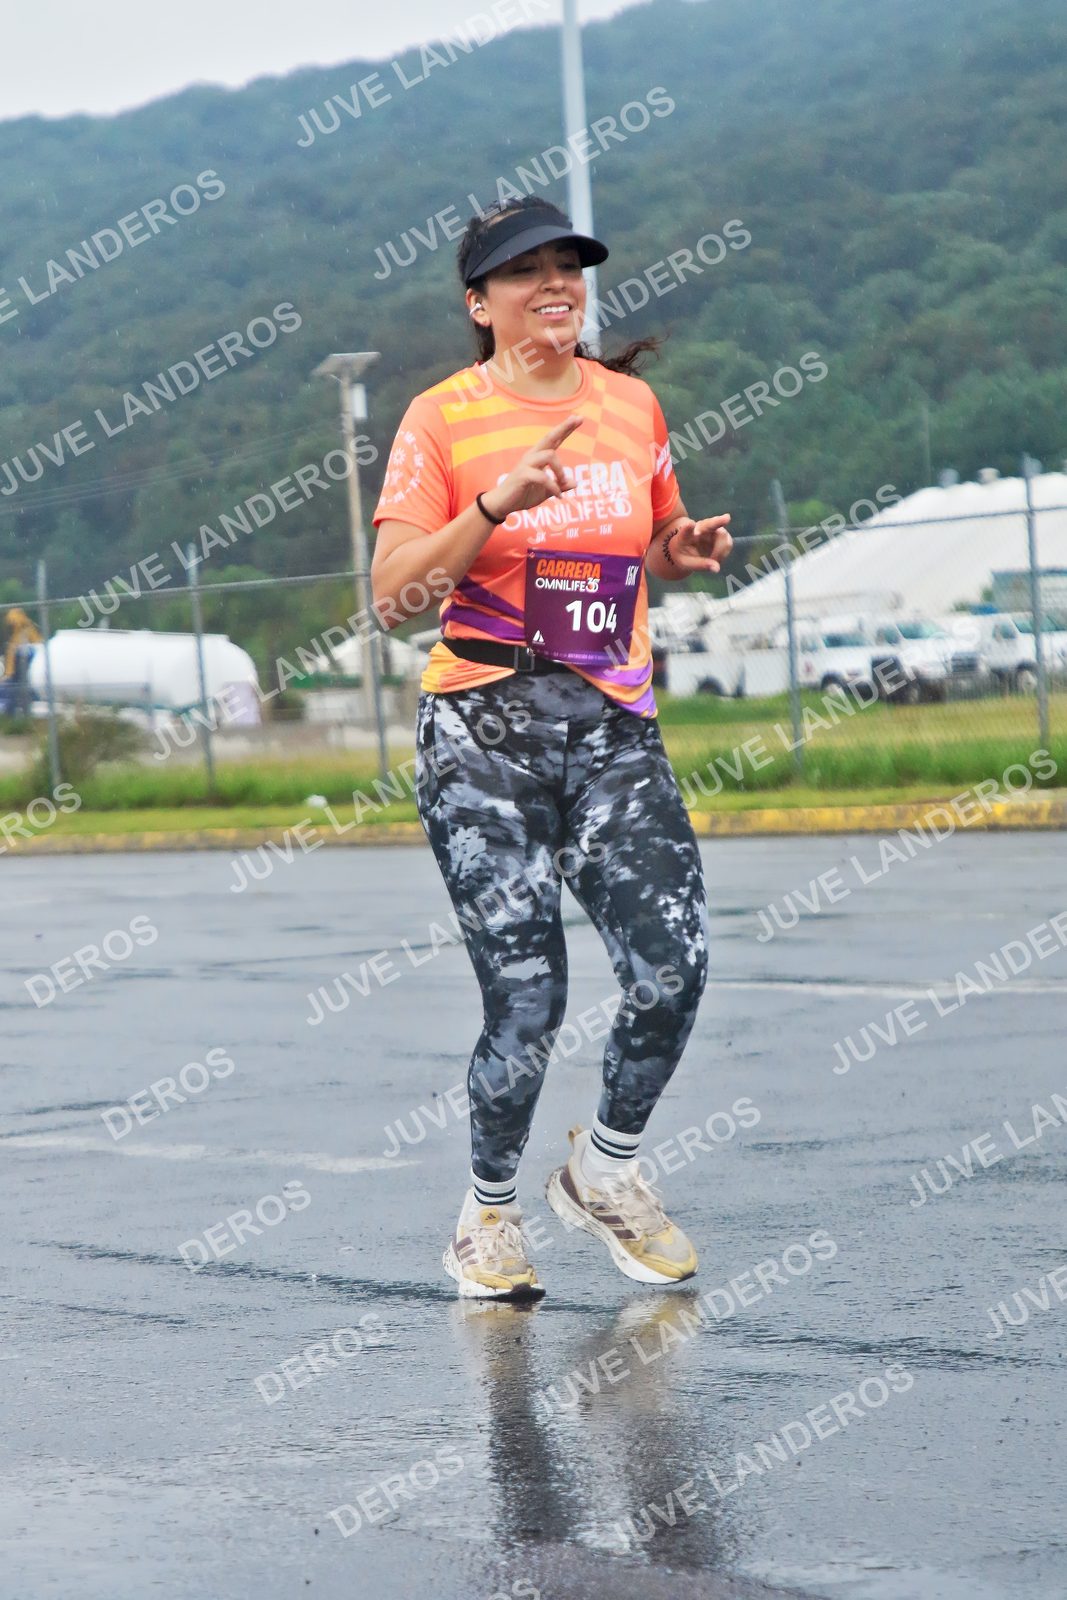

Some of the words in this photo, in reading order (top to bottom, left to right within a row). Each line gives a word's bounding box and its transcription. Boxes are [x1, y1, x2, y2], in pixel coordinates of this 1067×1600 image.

[536, 559, 601, 579] CARRERA
[625, 565, 640, 586] 15K
[565, 597, 617, 634] 104
